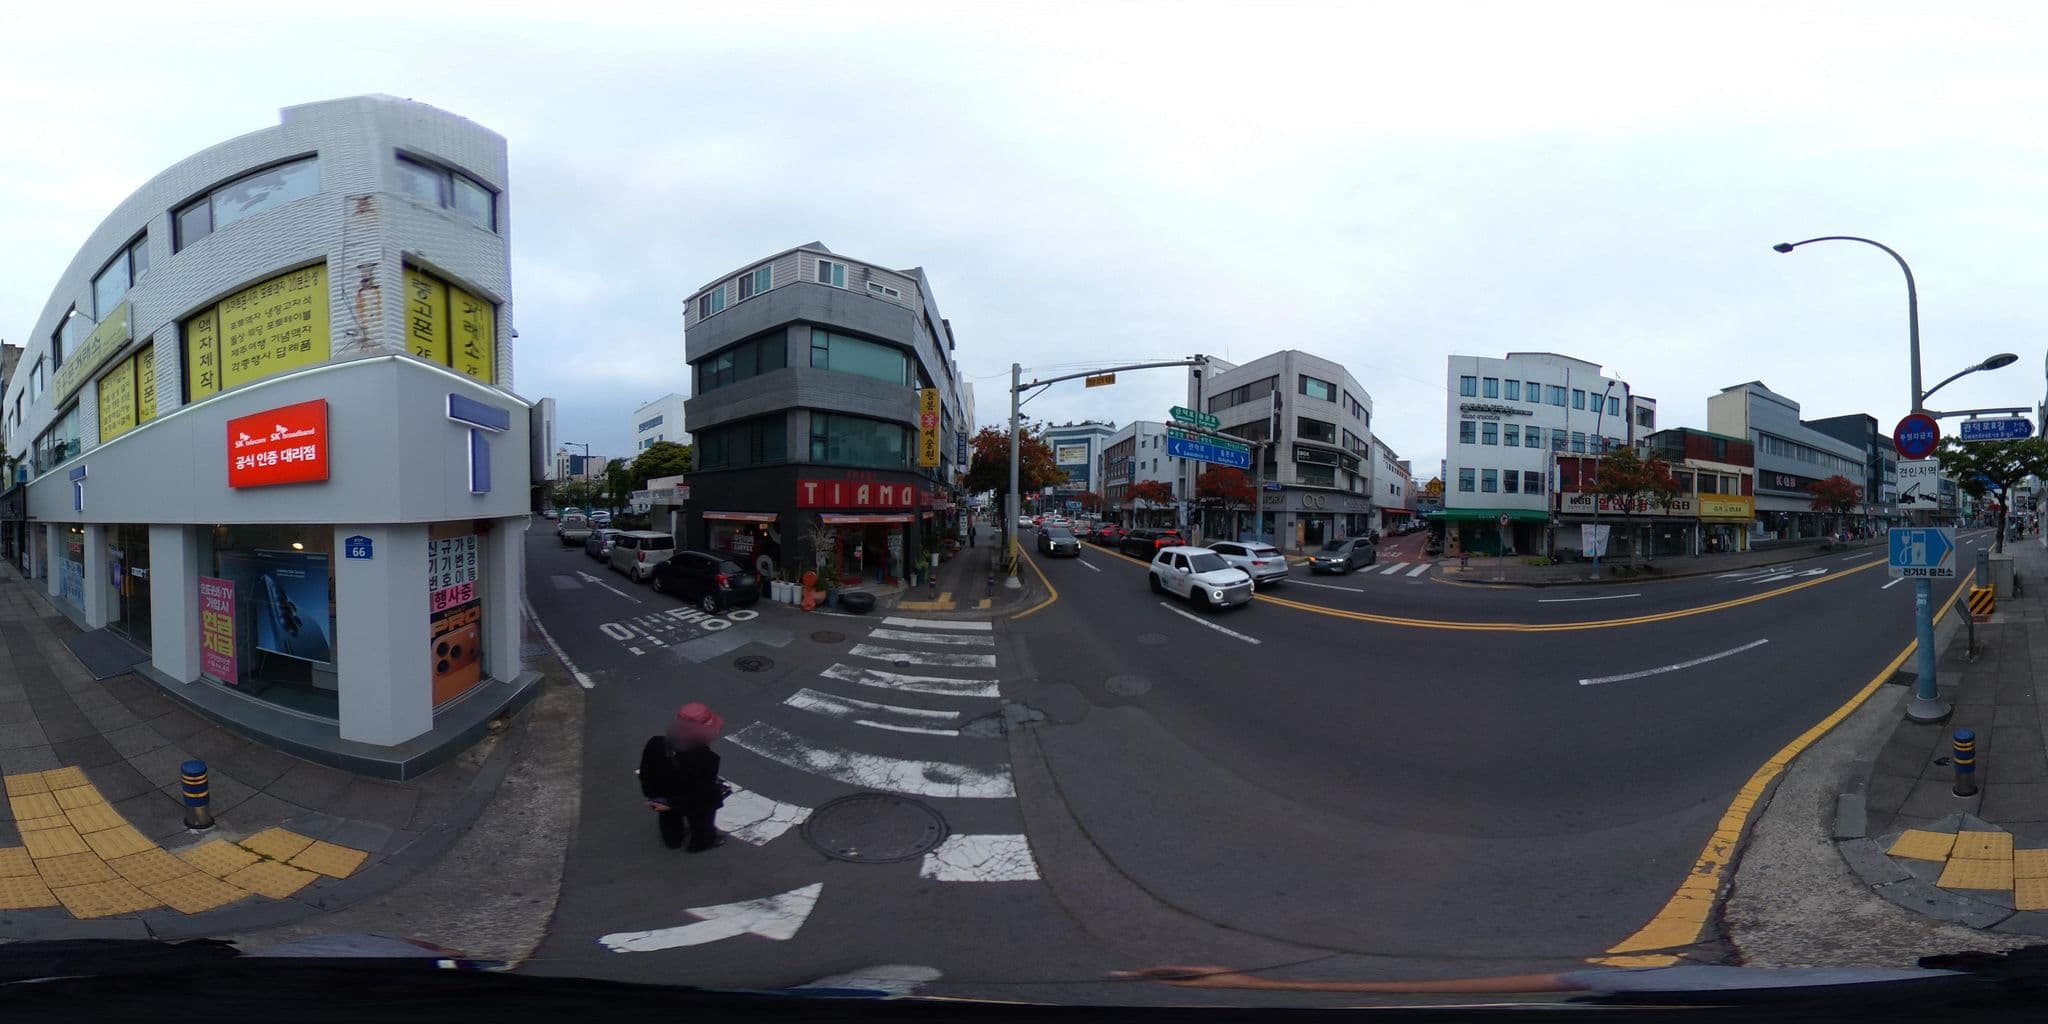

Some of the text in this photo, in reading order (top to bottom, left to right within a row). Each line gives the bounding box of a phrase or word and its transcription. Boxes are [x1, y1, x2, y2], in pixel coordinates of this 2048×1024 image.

[265, 295, 312, 318] 냉장고자석
[412, 278, 432, 343] 중고폰
[198, 316, 214, 389] 액자제작
[231, 325, 312, 357] 제주여행 기념액자
[416, 346, 432, 359] 2F
[231, 340, 311, 372] 각종행사 답례품
[467, 364, 477, 376] 2F
[282, 427, 315, 440] broadband
[235, 444, 316, 470] 공식 인증 대리점
[804, 482, 913, 506] TIAMO
[352, 547, 366, 557] 66
[428, 536, 476, 558] 신규가입
[428, 551, 476, 574] 기기변경
[1903, 567, 1953, 577] 전기차 충전소
[429, 566, 477, 592] 번호이동
[434, 582, 472, 610] 행사중
[204, 631, 233, 657] 지급
